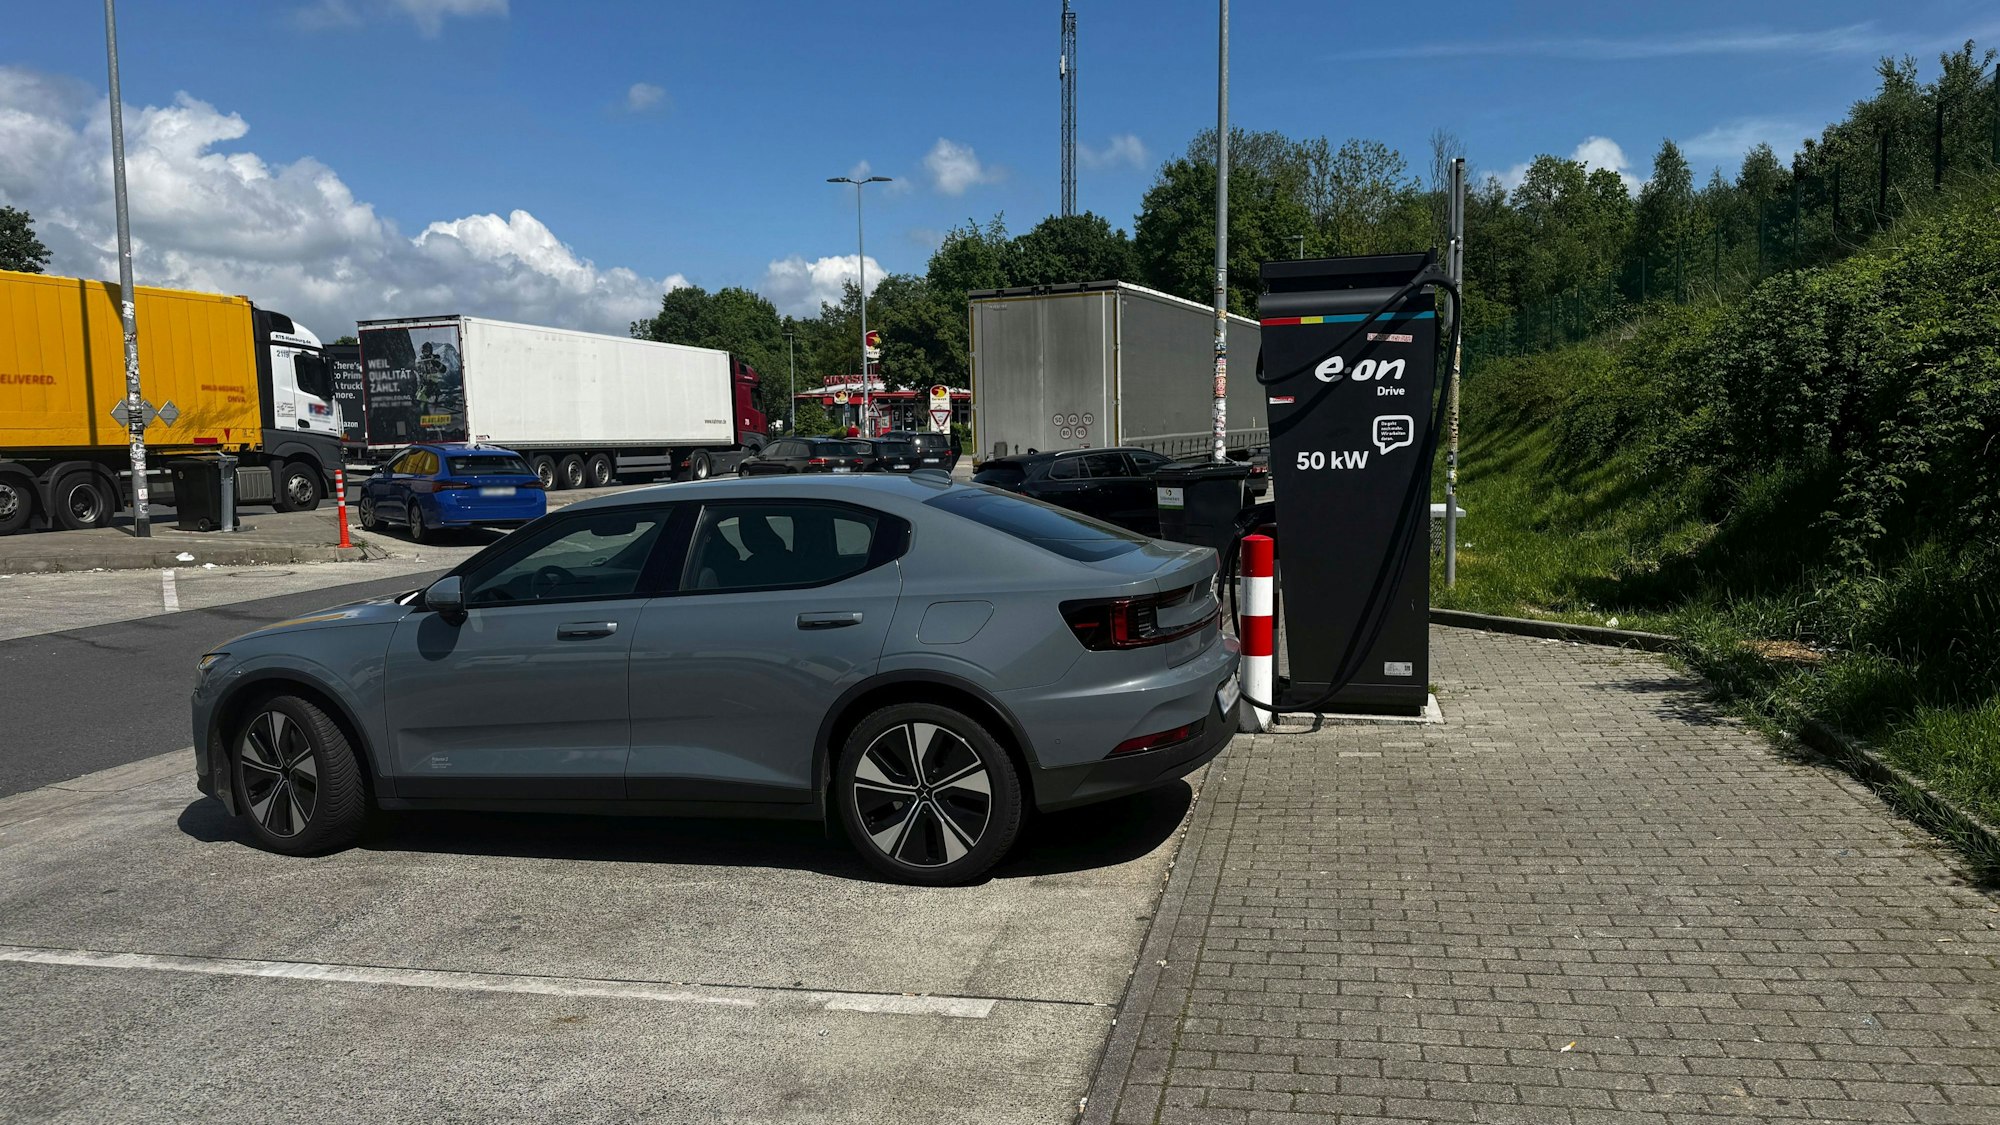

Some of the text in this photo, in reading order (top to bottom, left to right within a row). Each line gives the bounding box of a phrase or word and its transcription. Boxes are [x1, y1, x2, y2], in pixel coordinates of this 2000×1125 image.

[368, 359, 390, 369] WEIL
[369, 368, 411, 382] QUALITÄT
[1377, 386, 1405, 396] Drive
[1297, 450, 1369, 470] 50 kW
